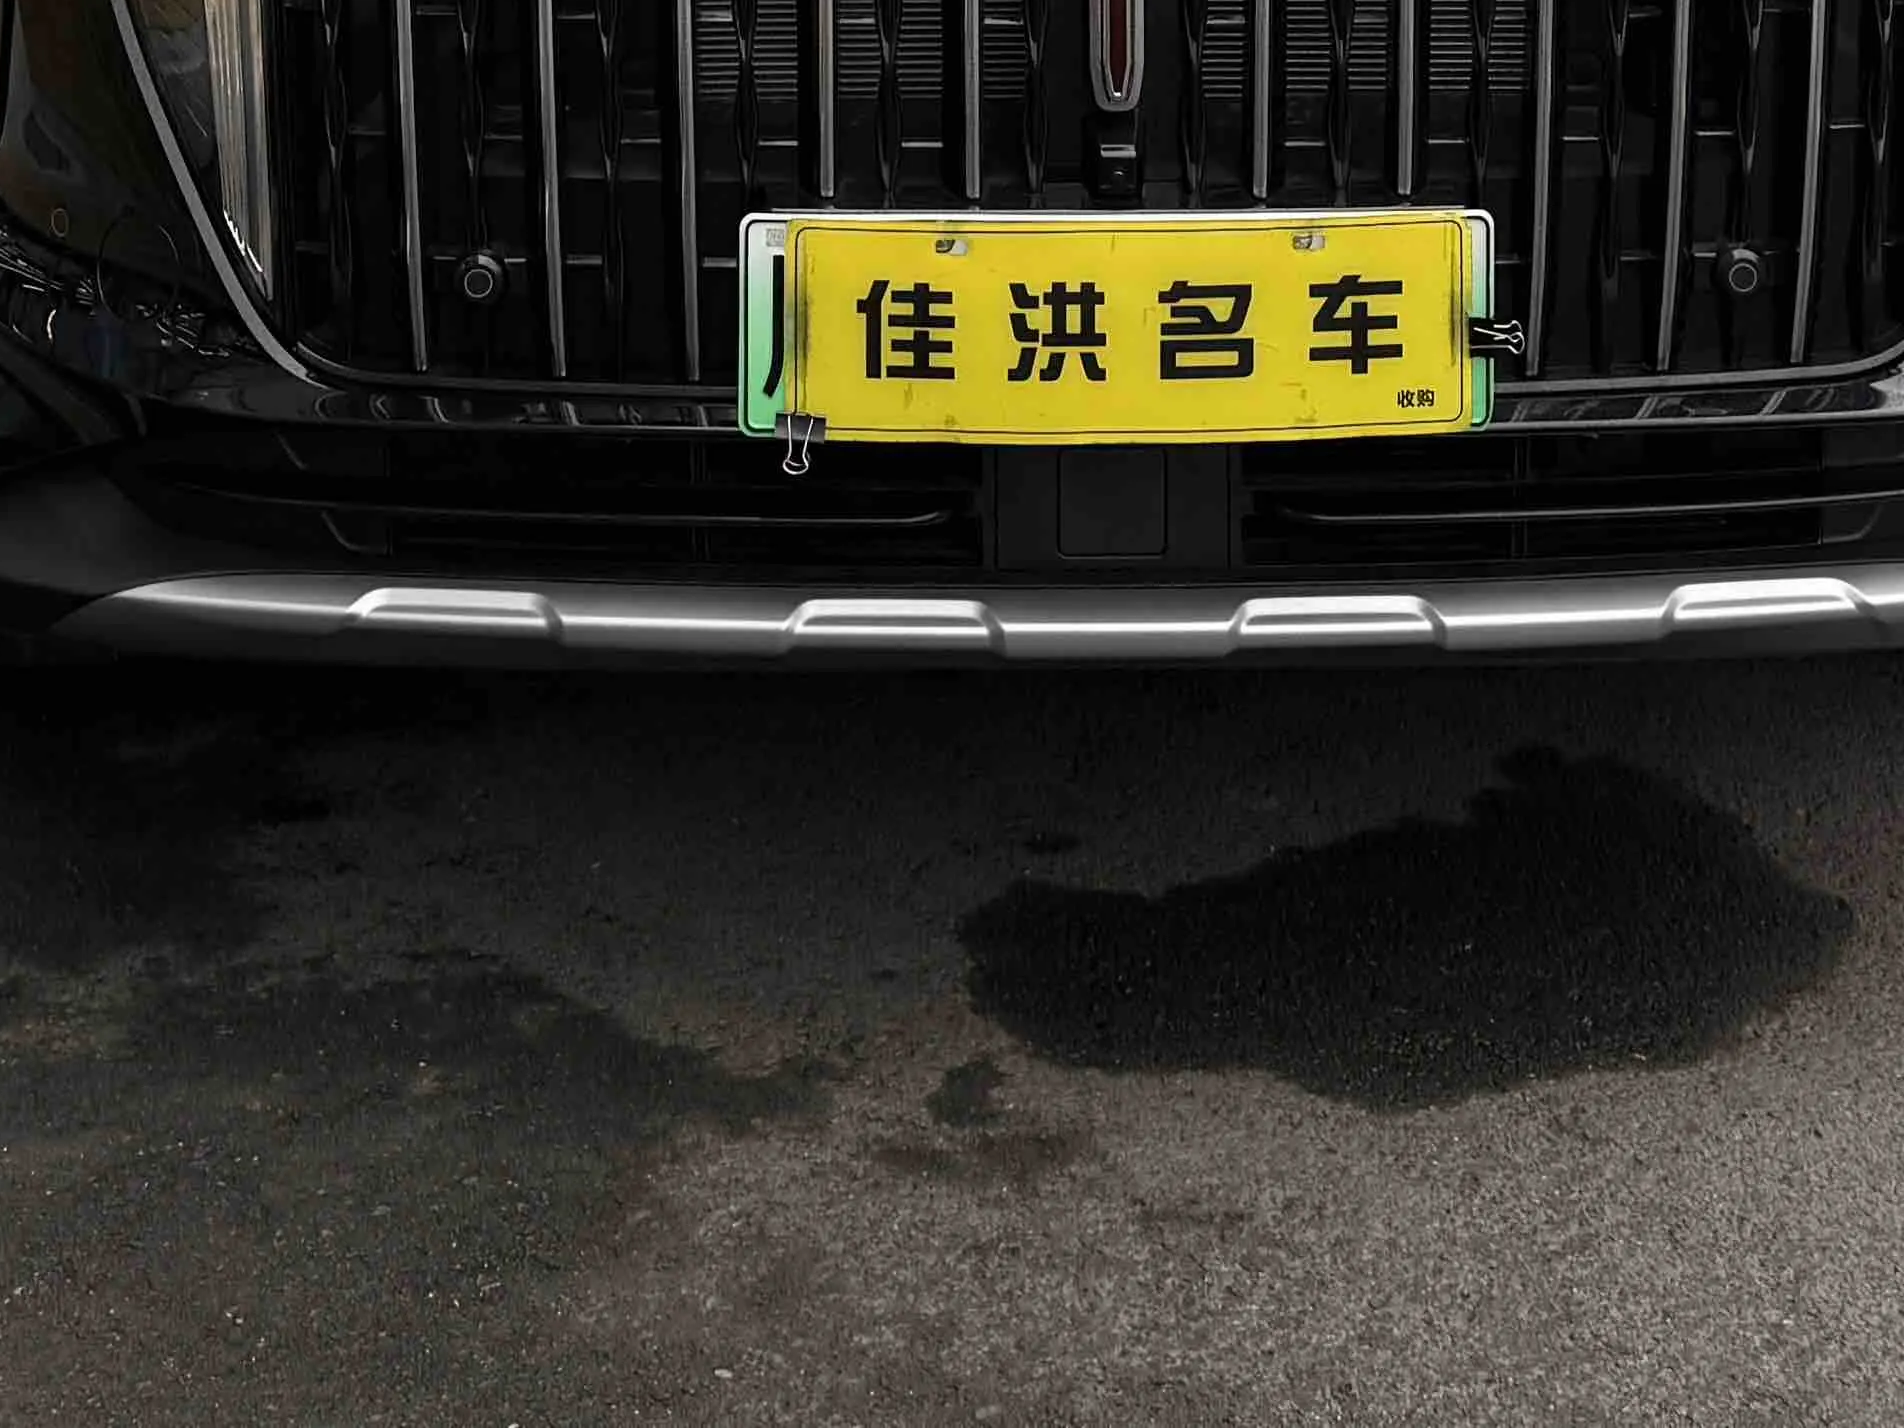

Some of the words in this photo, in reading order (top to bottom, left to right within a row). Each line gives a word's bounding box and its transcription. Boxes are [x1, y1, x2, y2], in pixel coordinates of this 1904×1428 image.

[856, 274, 1404, 381] 佳洪名车
[1397, 389, 1436, 408] 收购
